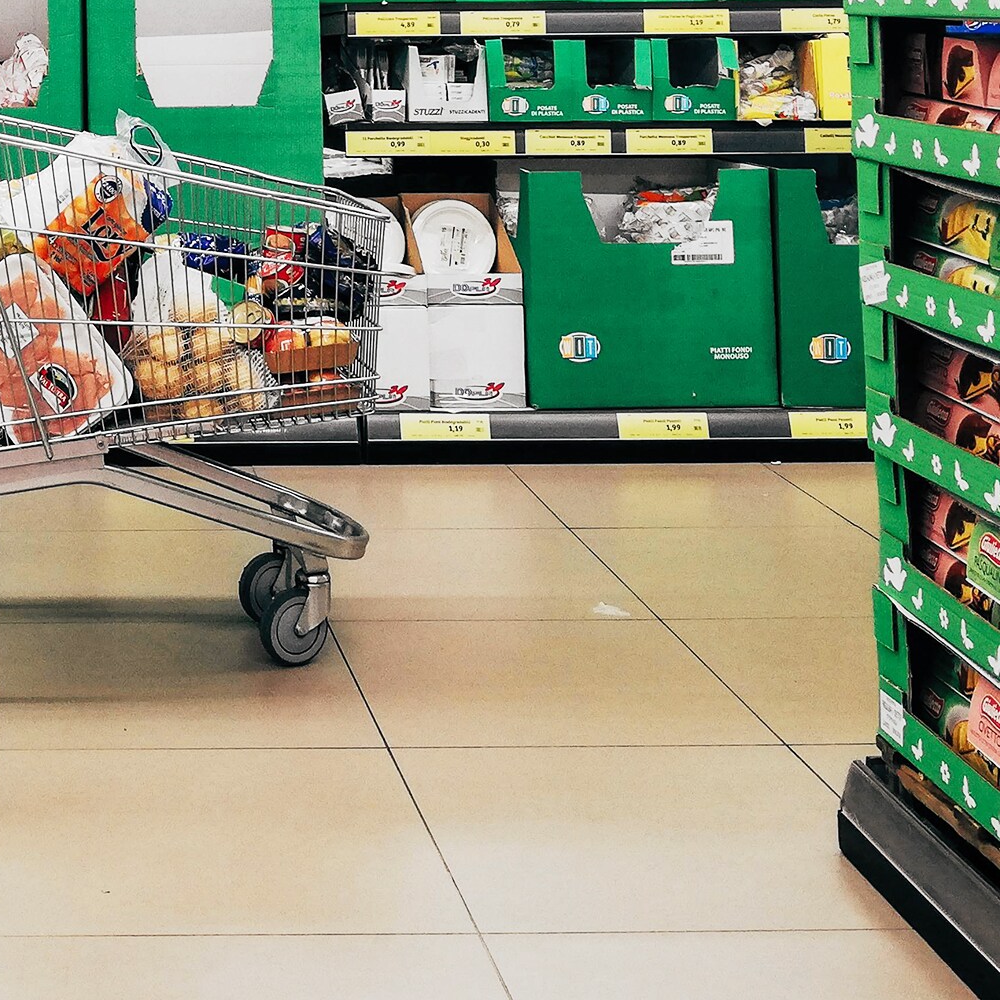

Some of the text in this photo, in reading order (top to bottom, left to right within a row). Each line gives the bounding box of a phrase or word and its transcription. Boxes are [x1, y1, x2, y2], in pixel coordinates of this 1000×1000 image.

[828, 18, 841, 26] 1,79
[390, 140, 406, 148] 0,99
[476, 140, 490, 148] 0,30
[732, 346, 752, 354] FONDI
[666, 424, 681, 432] 1,99
[838, 422, 854, 430] 1,99
